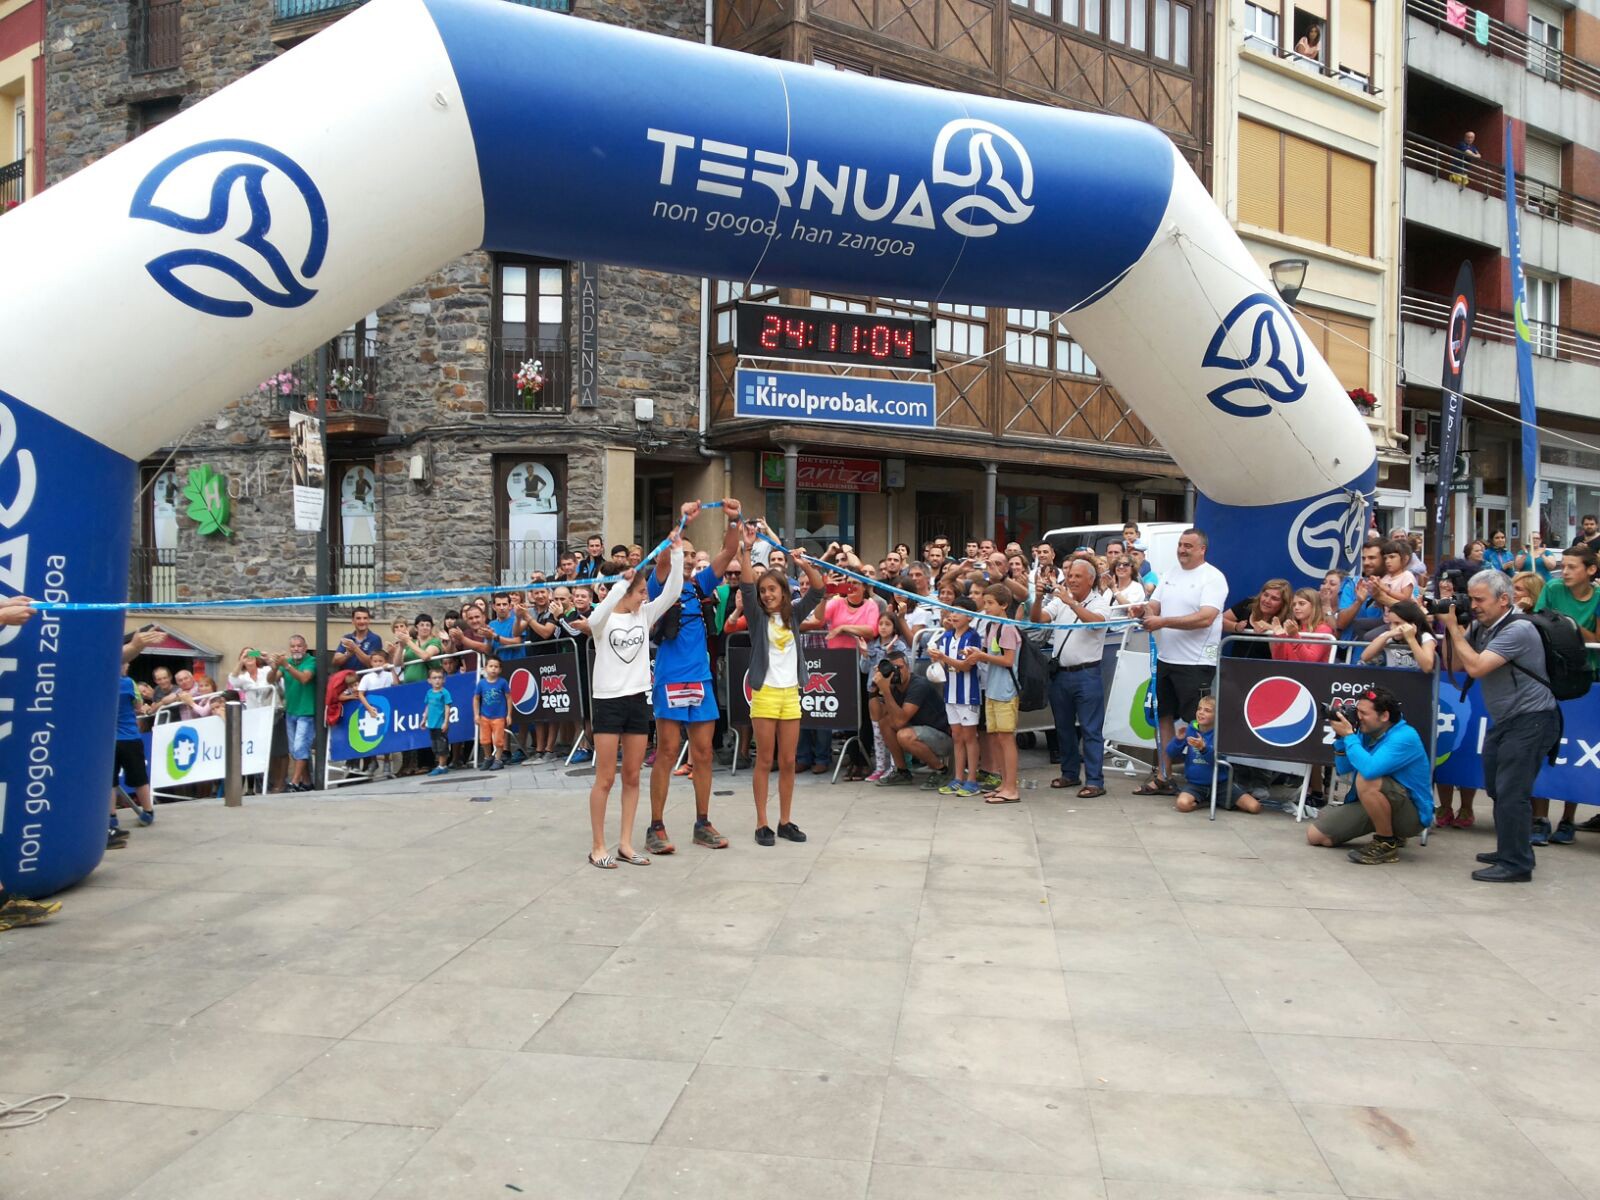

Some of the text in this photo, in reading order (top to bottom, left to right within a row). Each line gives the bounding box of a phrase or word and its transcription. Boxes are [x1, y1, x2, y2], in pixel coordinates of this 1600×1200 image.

[647, 128, 936, 230] TERNUA
[653, 201, 915, 257] non gogoa, han zangoa
[761, 315, 913, 357] 24:11:04
[756, 385, 928, 417] Kirolprobak.com
[804, 659, 822, 669] psi
[27, 663, 56, 712] han
[803, 672, 838, 694] AX
[541, 693, 571, 709] zero
[798, 694, 839, 712] ero
[394, 706, 460, 732] kua
[202, 740, 254, 762] kua
[25, 722, 55, 814] gogoa,
[18, 823, 42, 873] non
